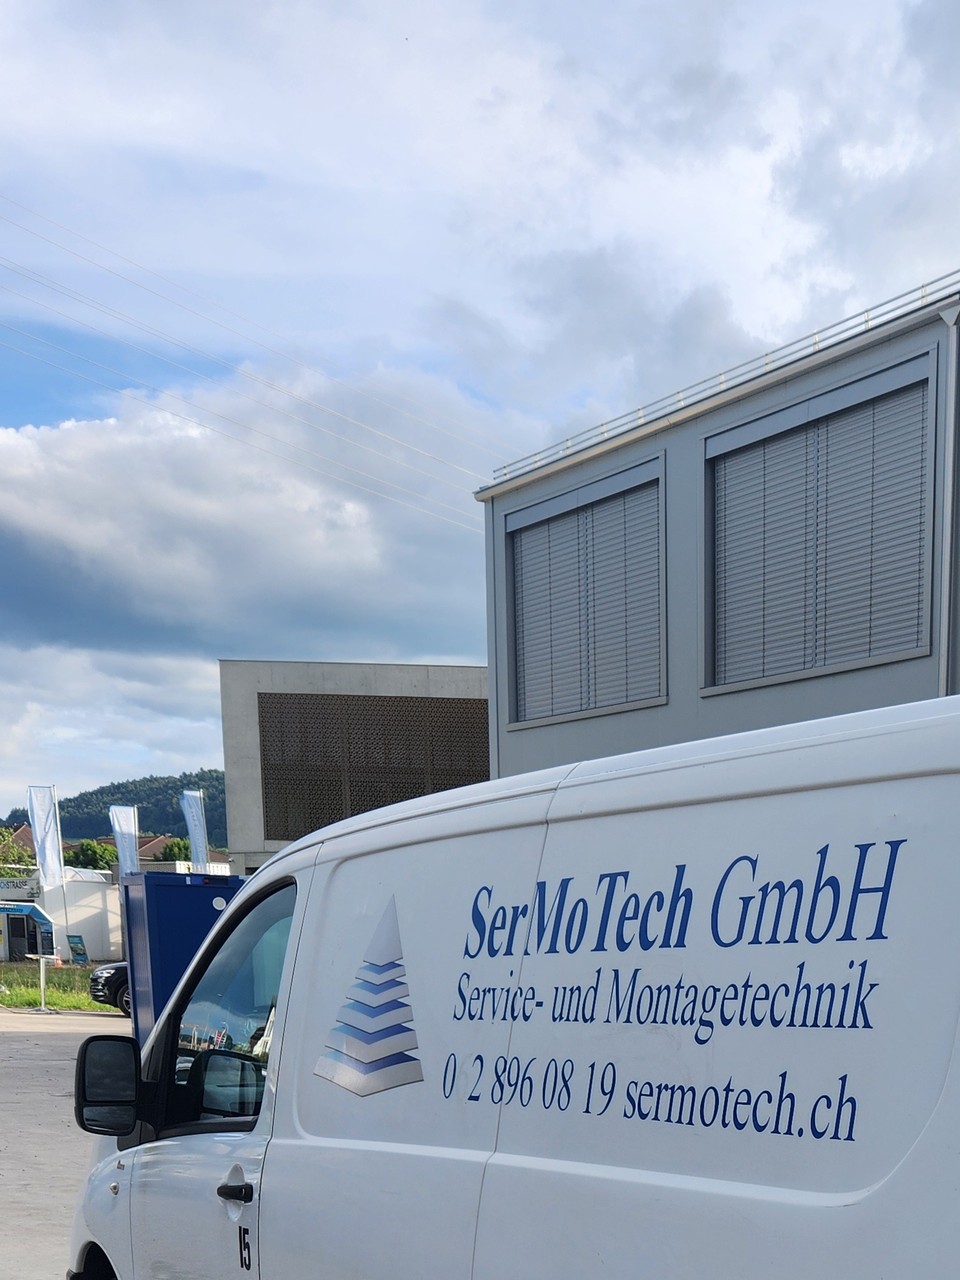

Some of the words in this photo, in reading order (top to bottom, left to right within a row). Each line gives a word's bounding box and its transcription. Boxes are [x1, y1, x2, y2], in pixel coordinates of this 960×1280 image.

[463, 864, 694, 960] SerMoTech
[710, 838, 908, 949] GmbH
[452, 971, 544, 1025] Service-
[550, 966, 602, 1025] und
[604, 959, 880, 1046] Montagetechnik
[489, 1055, 534, 1110] 896
[541, 1058, 574, 1112] 08
[583, 1061, 618, 1117] 19
[622, 1070, 858, 1143] sermotech.ch
[239, 1226, 251, 1271] 15
